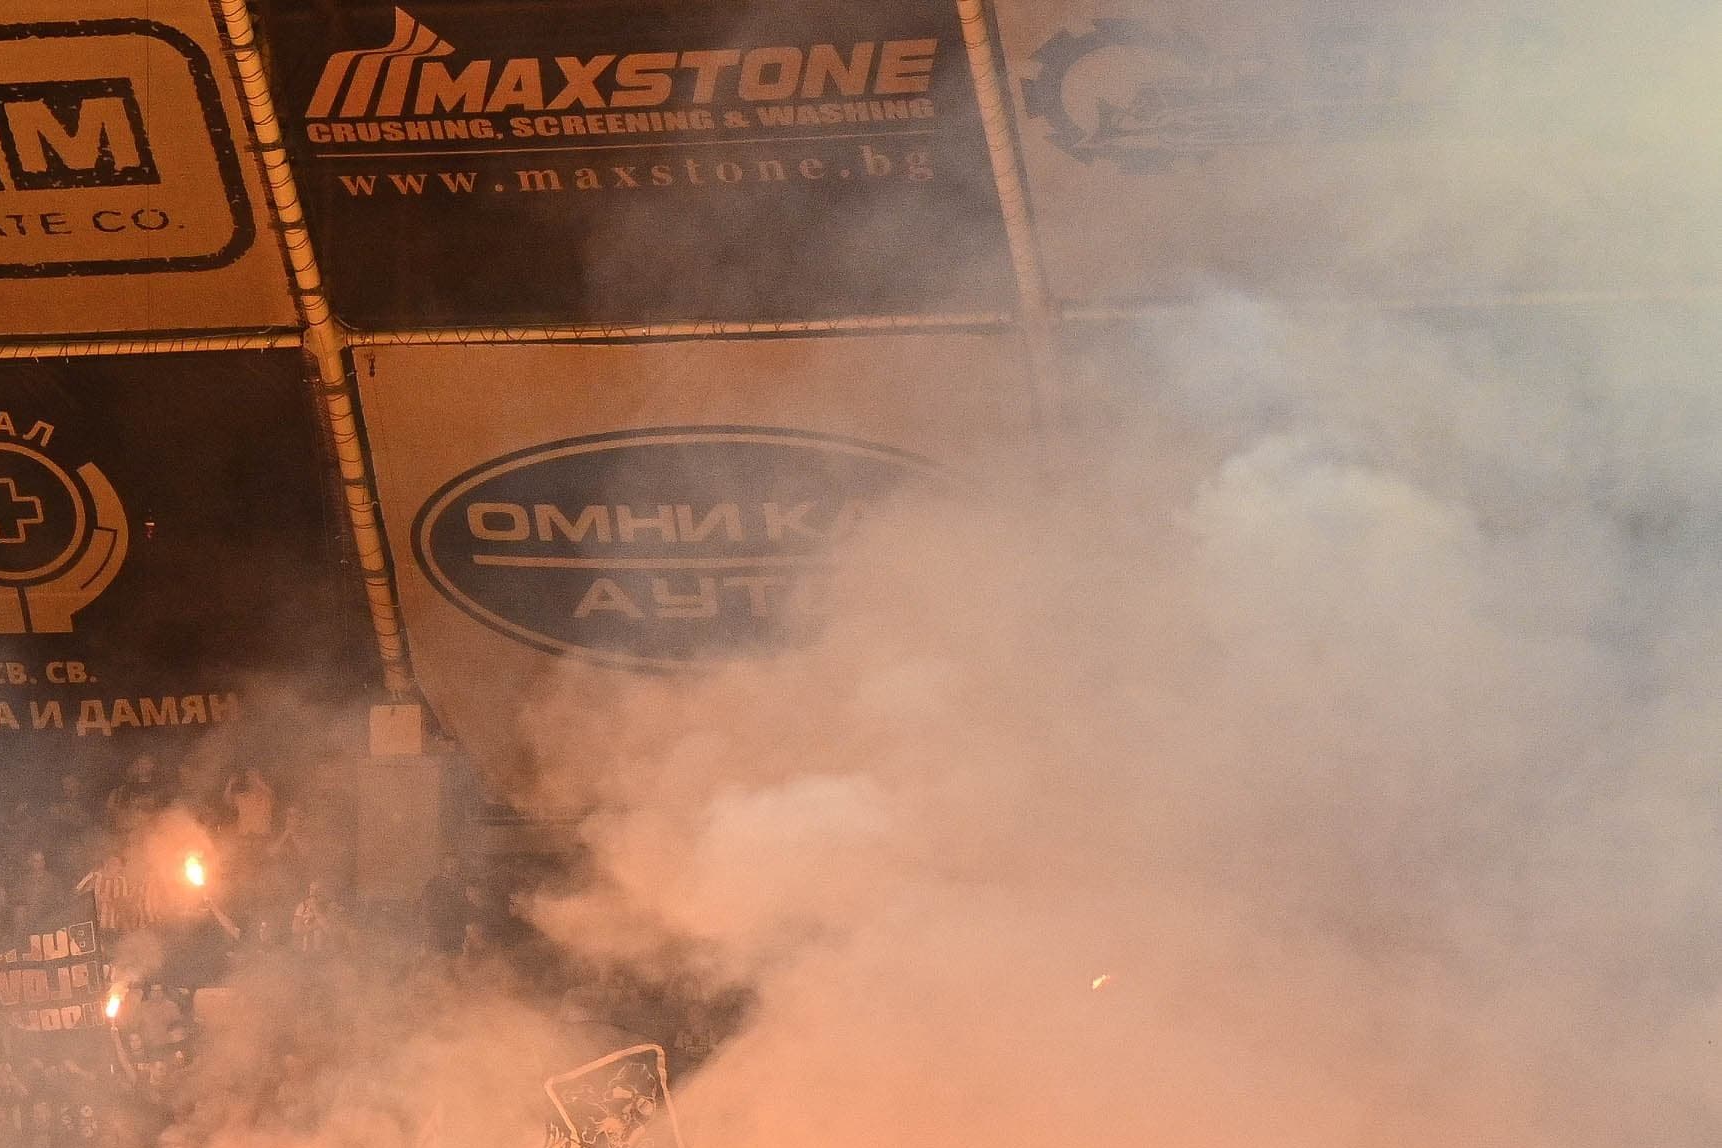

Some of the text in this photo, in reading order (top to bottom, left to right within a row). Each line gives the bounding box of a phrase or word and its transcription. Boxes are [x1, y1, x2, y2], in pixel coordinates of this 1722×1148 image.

[414, 39, 938, 115] MAXSTONE
[307, 99, 935, 144] CRUSHING, SCREENING & WASHING
[341, 146, 936, 198] www.maxstone.bg
[91, 209, 186, 235] CO.
[466, 501, 863, 544] ОМНИК
[28, 702, 64, 731] И
[75, 691, 240, 737] ДАМЯН
